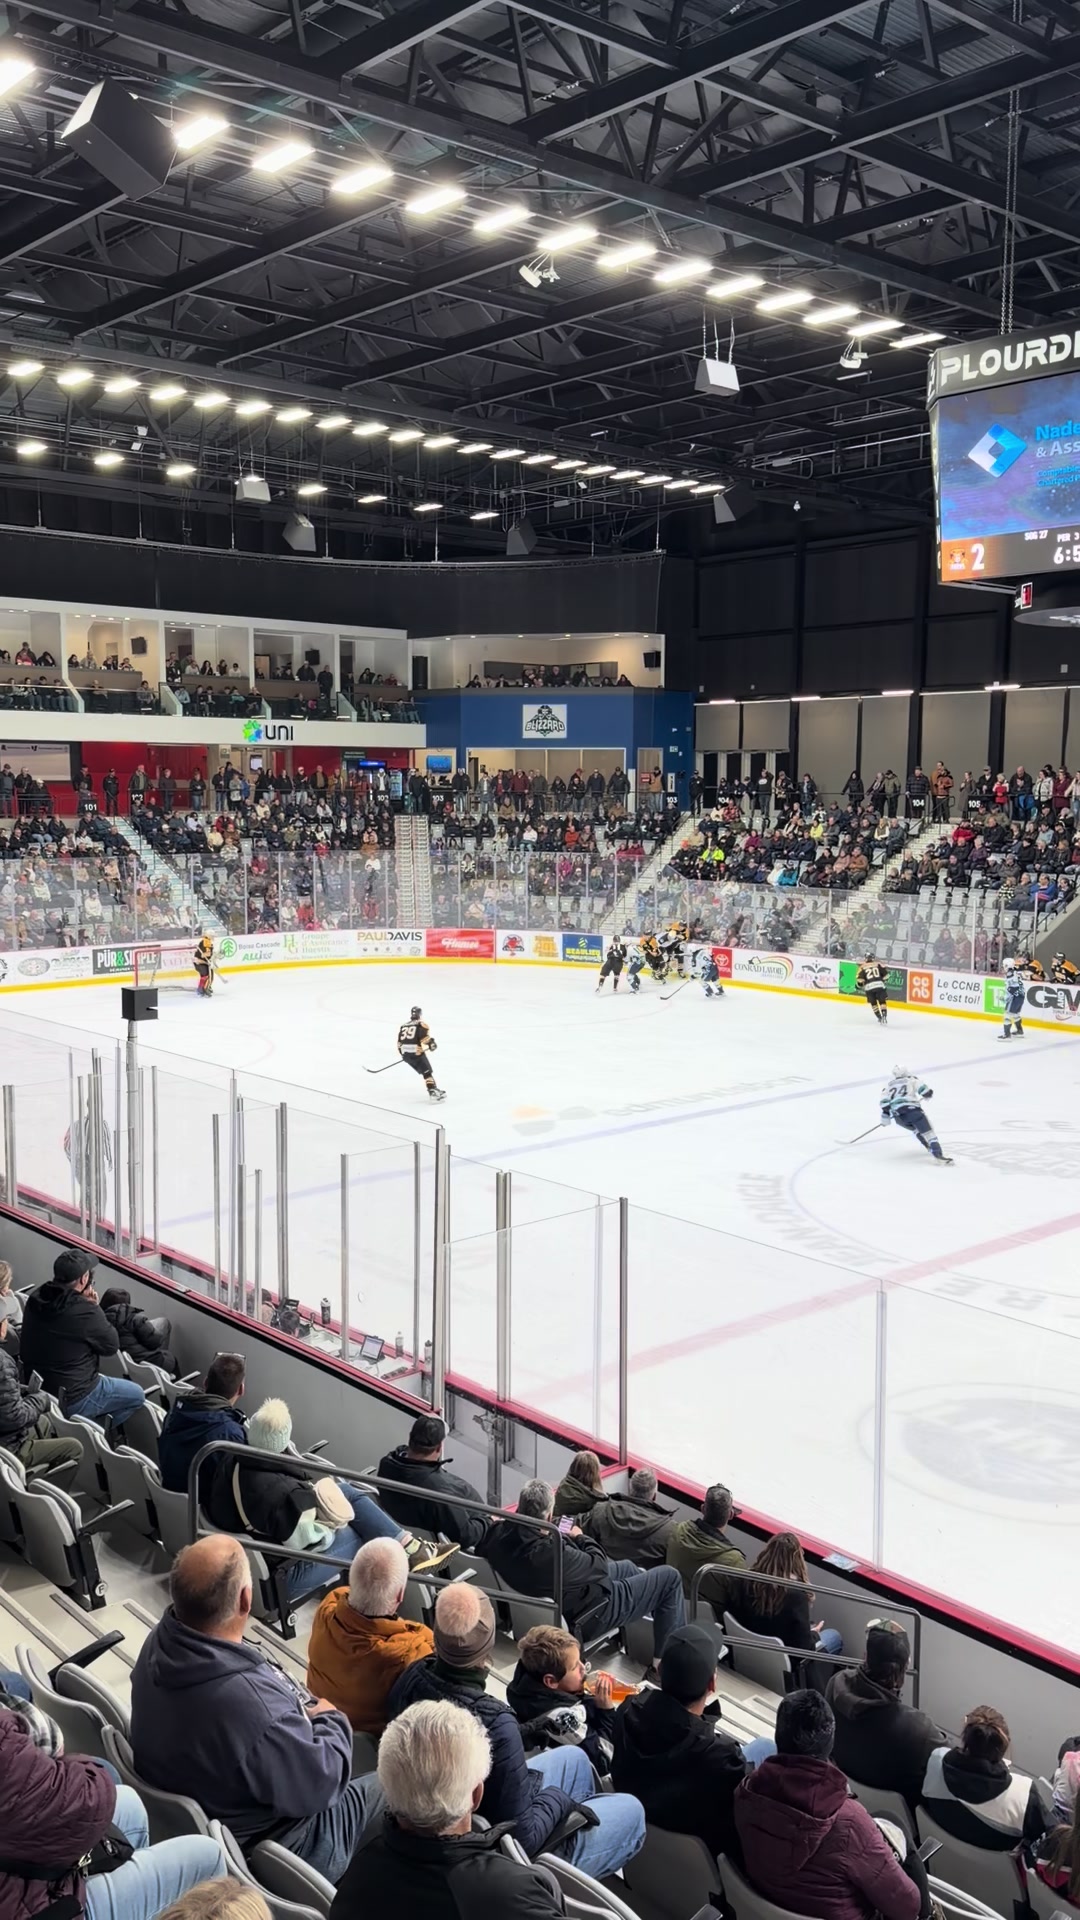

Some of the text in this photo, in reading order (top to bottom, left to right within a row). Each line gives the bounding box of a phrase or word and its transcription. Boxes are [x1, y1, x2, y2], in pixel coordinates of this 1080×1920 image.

[1036, 447, 1047, 458] &
[1057, 532, 1080, 542] PER 3
[971, 543, 985, 570] 2
[525, 719, 565, 731] BLIZZARD
[264, 724, 294, 741] UNI
[84, 803, 97, 811] 101
[912, 799, 925, 807] 104
[968, 800, 981, 808] 105
[255, 941, 281, 949] Cascade
[865, 967, 880, 980] 20
[937, 979, 983, 994] Le CCNB,
[939, 992, 981, 1005] c'est toi!
[401, 1026, 416, 1040] 39
